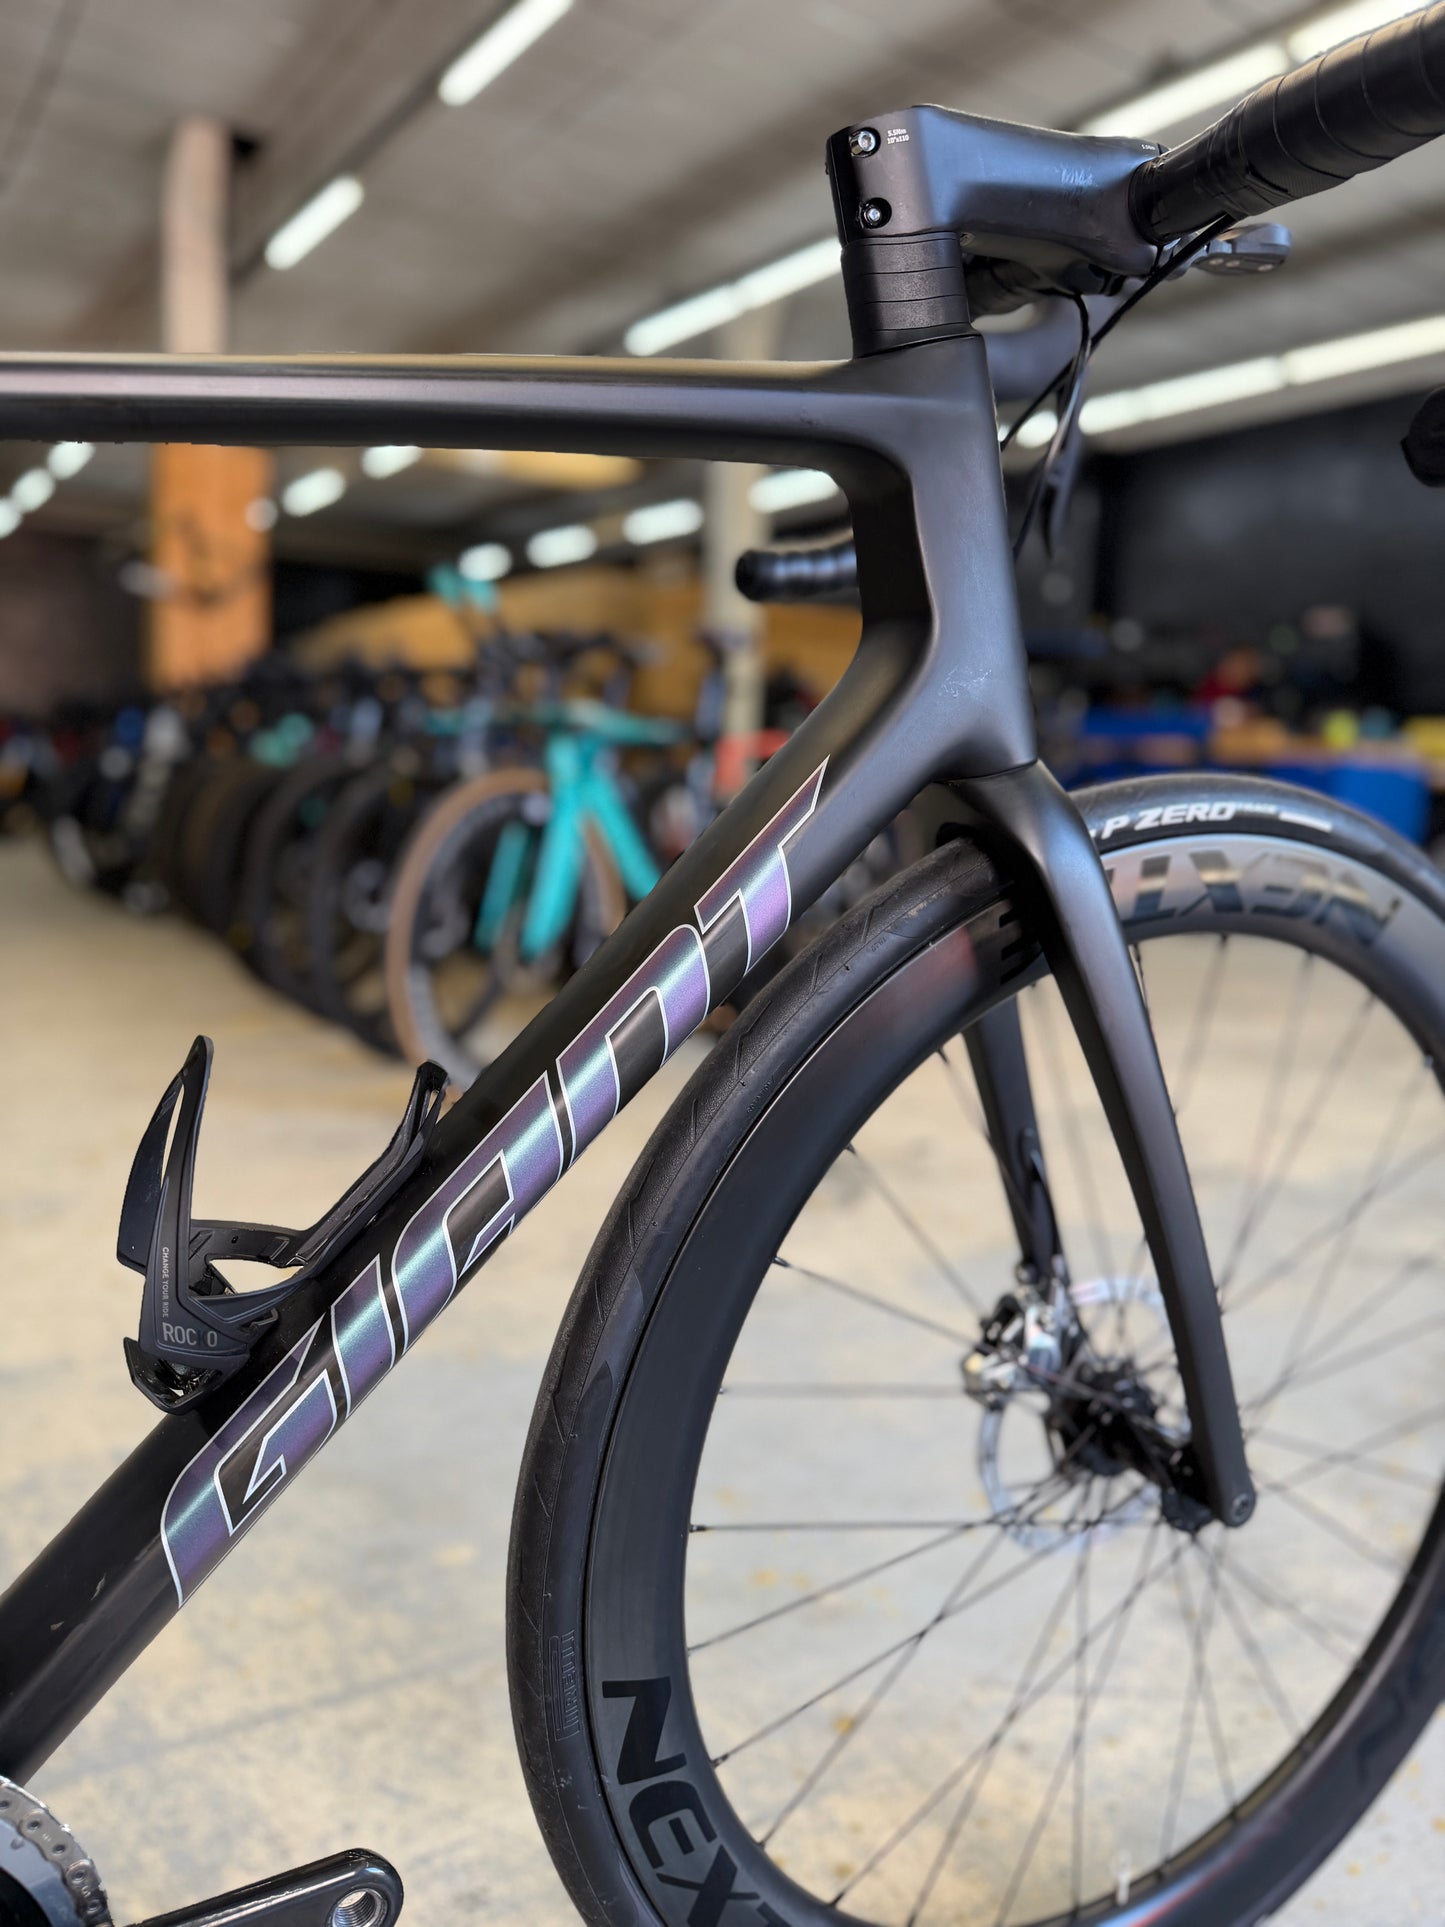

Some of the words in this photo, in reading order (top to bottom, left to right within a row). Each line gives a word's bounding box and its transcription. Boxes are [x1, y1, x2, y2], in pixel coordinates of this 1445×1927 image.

[1101, 814, 1130, 840] P
[1134, 801, 1237, 831] ZERO
[161, 756, 830, 1606] GIANT
[161, 1246, 170, 1278] CHANGE
[161, 1279, 170, 1299] YOUR
[161, 1301, 170, 1318] RIDE
[547, 1628, 582, 1742] PIRELLI
